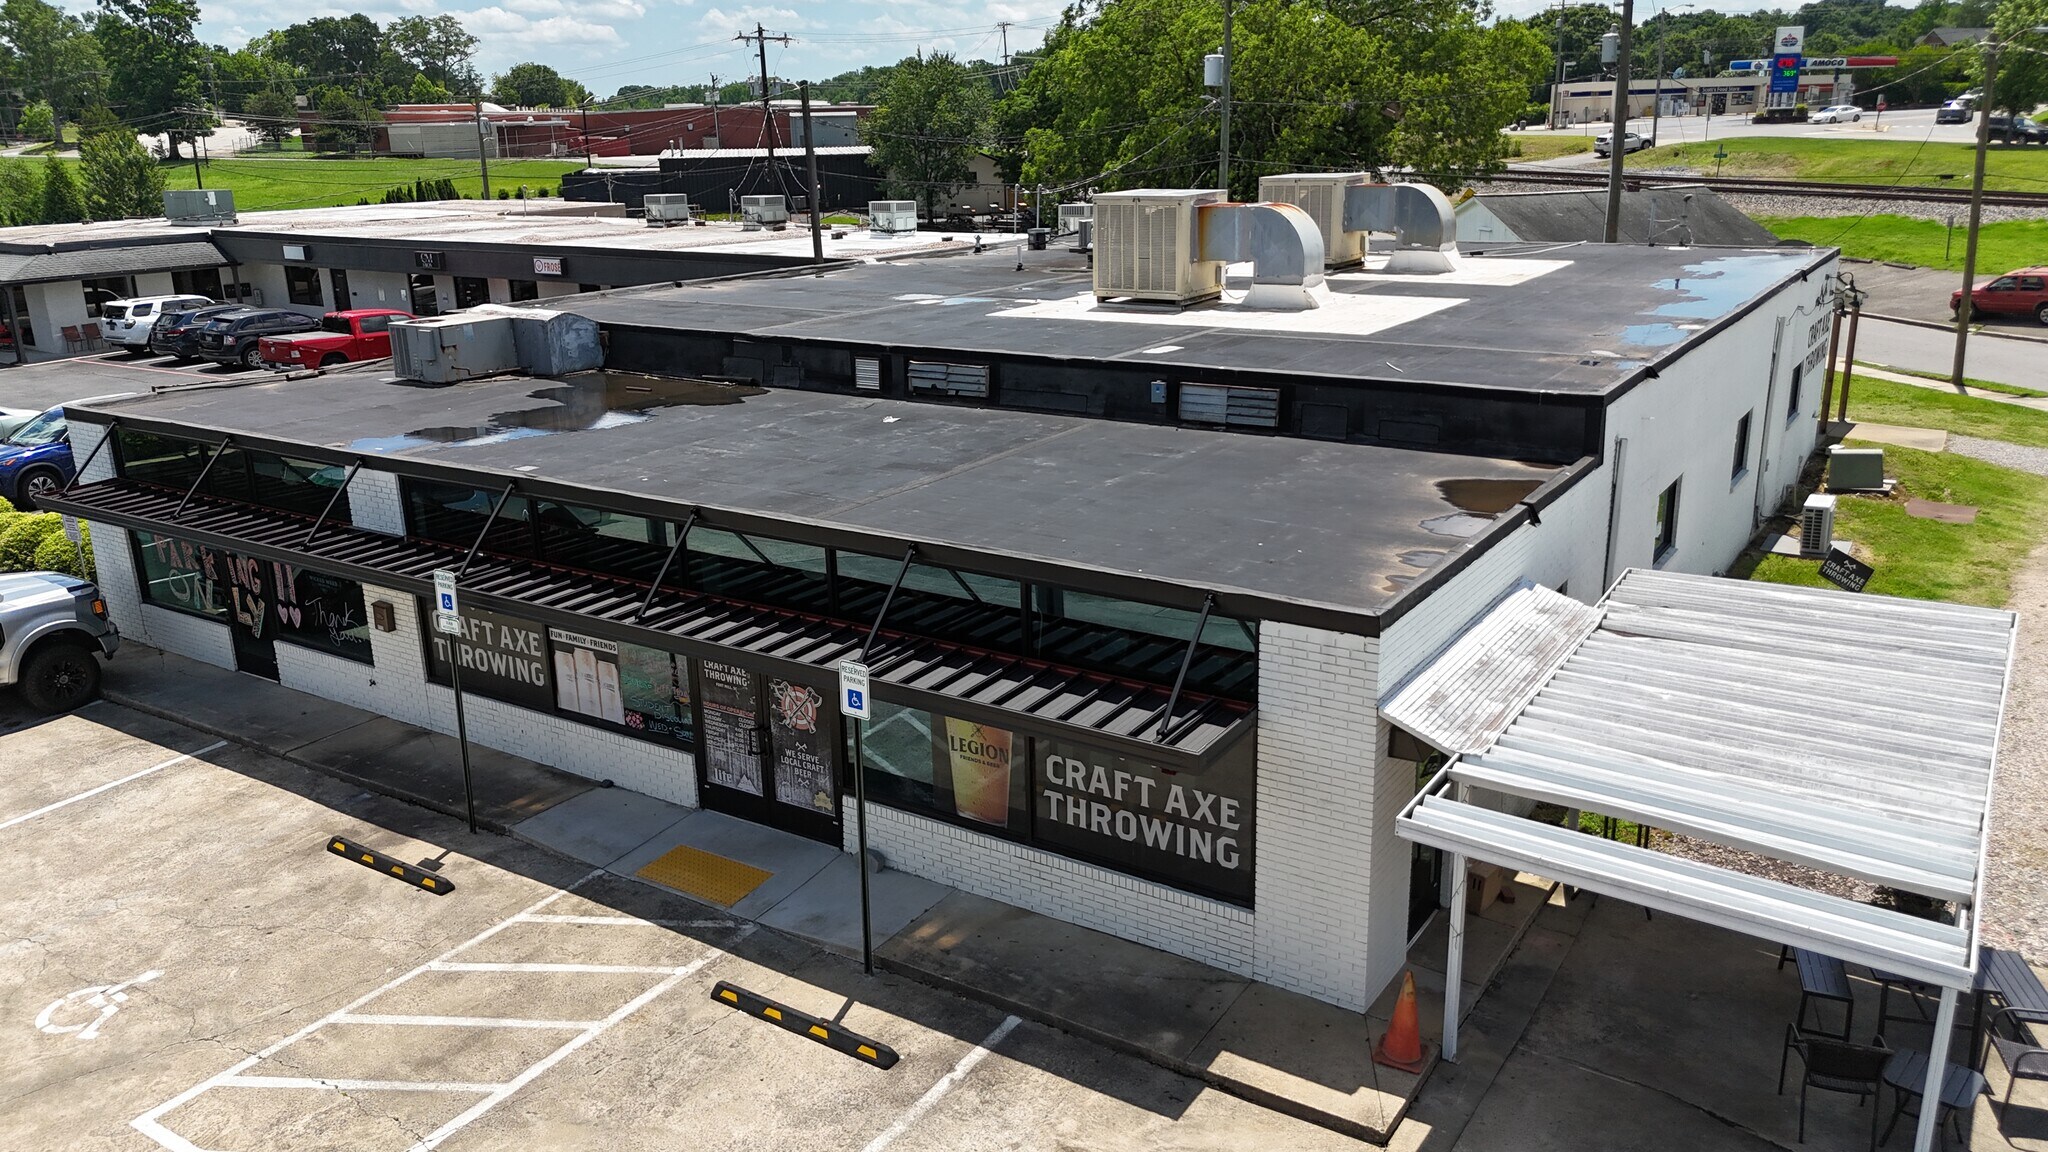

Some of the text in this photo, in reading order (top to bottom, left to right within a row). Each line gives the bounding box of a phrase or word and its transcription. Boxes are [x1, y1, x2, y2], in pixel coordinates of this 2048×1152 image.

[1822, 565, 1861, 591] THROWING
[1826, 560, 1866, 587] CRAFT AXE
[438, 581, 453, 590] PARKING
[305, 597, 360, 628] Thank
[432, 610, 542, 657] CAFT AXE
[550, 630, 617, 651] FUN FAMILY FRIENDS
[704, 668, 748, 687] THROWING
[841, 665, 866, 677] RESERVED
[843, 675, 866, 687] PARKING
[631, 695, 672, 712] STUDENT
[704, 709, 721, 717] MONDAY
[785, 748, 820, 764] WE SERVE
[949, 735, 1009, 765] LEGION
[960, 754, 982, 764] FRIENDS
[781, 755, 824, 773] LOCAL CRAFT
[794, 768, 812, 779] BEER
[1046, 754, 1241, 832] CRAFT AXE
[1043, 789, 1240, 871] THROWING
